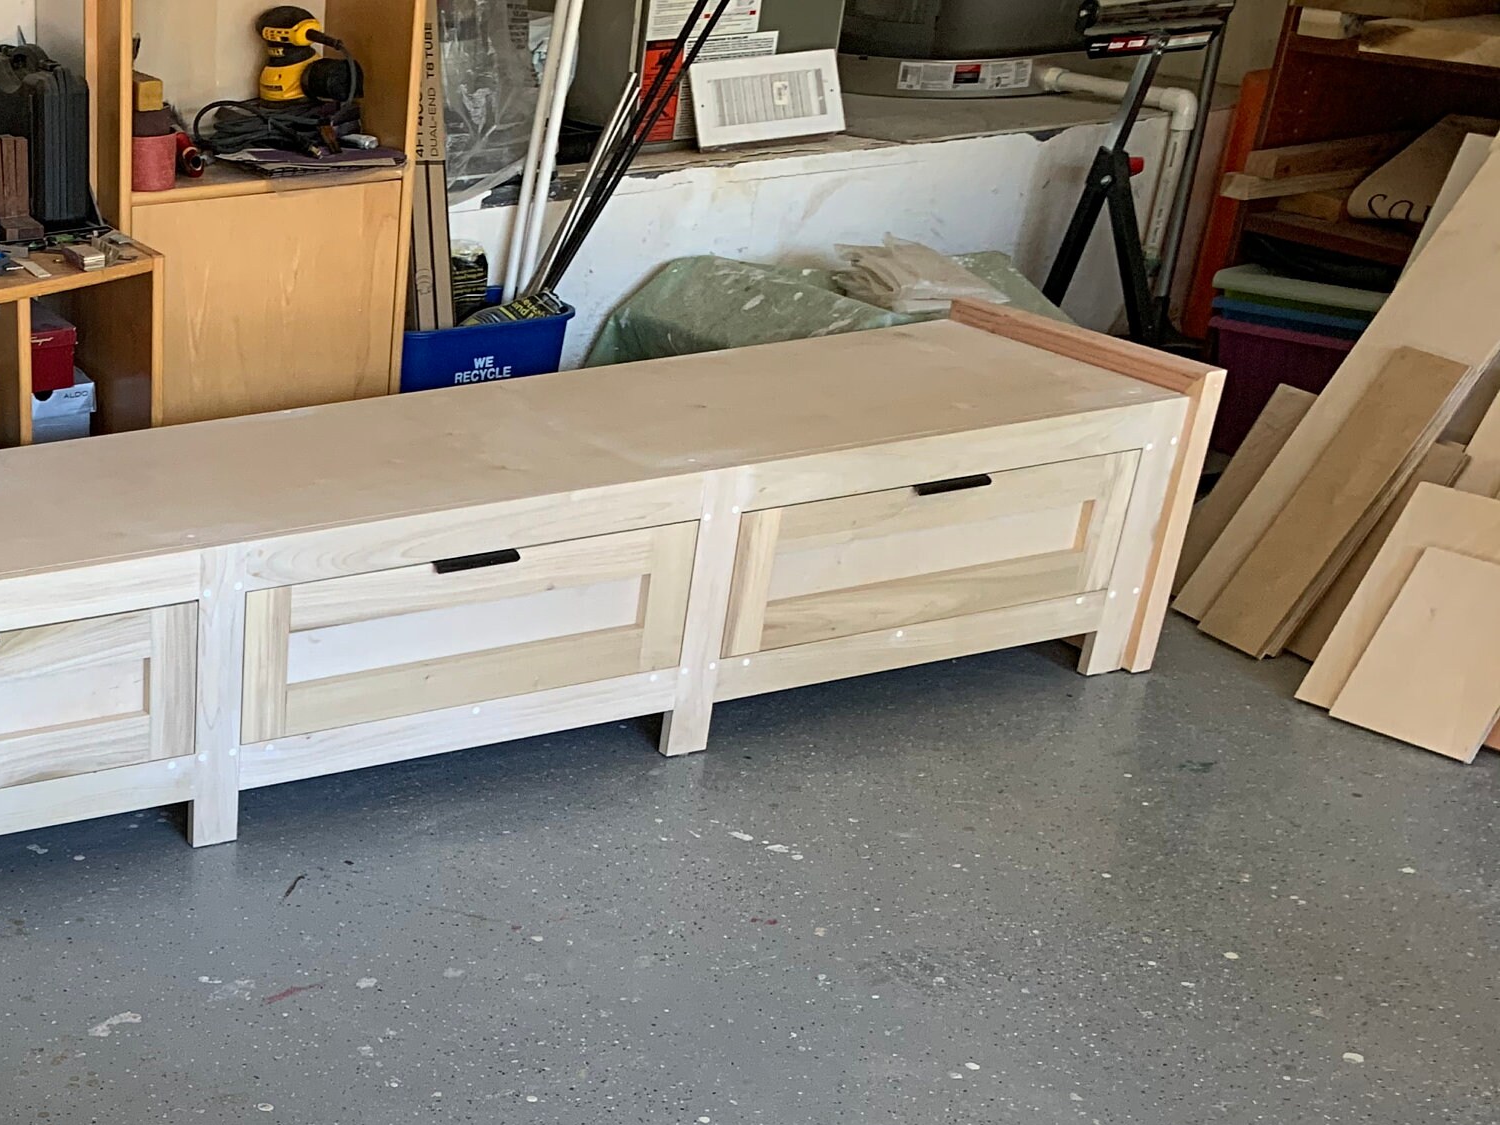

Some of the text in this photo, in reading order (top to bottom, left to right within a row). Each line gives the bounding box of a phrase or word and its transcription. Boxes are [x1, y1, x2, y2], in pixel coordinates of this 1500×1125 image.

[424, 22, 434, 59] TUBE
[426, 62, 435, 79] T8
[473, 356, 494, 369] WE
[454, 366, 512, 384] RECYCLE
[63, 390, 89, 399] ALDO
